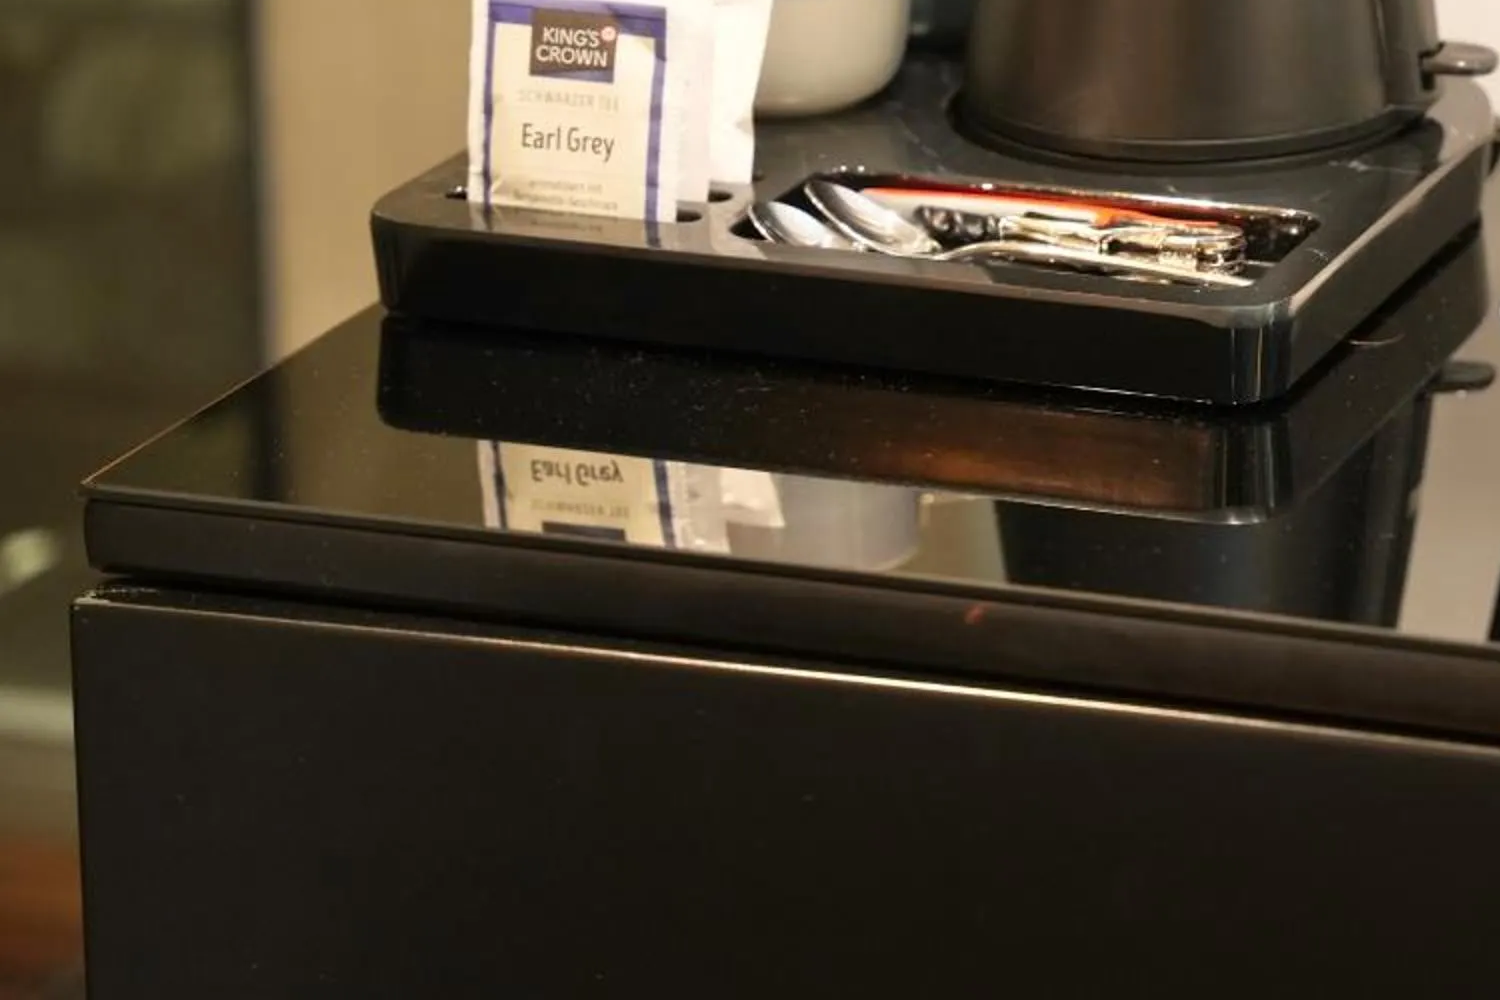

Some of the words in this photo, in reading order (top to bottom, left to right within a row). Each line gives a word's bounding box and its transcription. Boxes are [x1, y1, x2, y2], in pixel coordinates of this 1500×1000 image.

[543, 26, 600, 48] KING'S
[536, 45, 608, 67] CROWN
[521, 122, 561, 151] Earl
[566, 126, 615, 163] Grey
